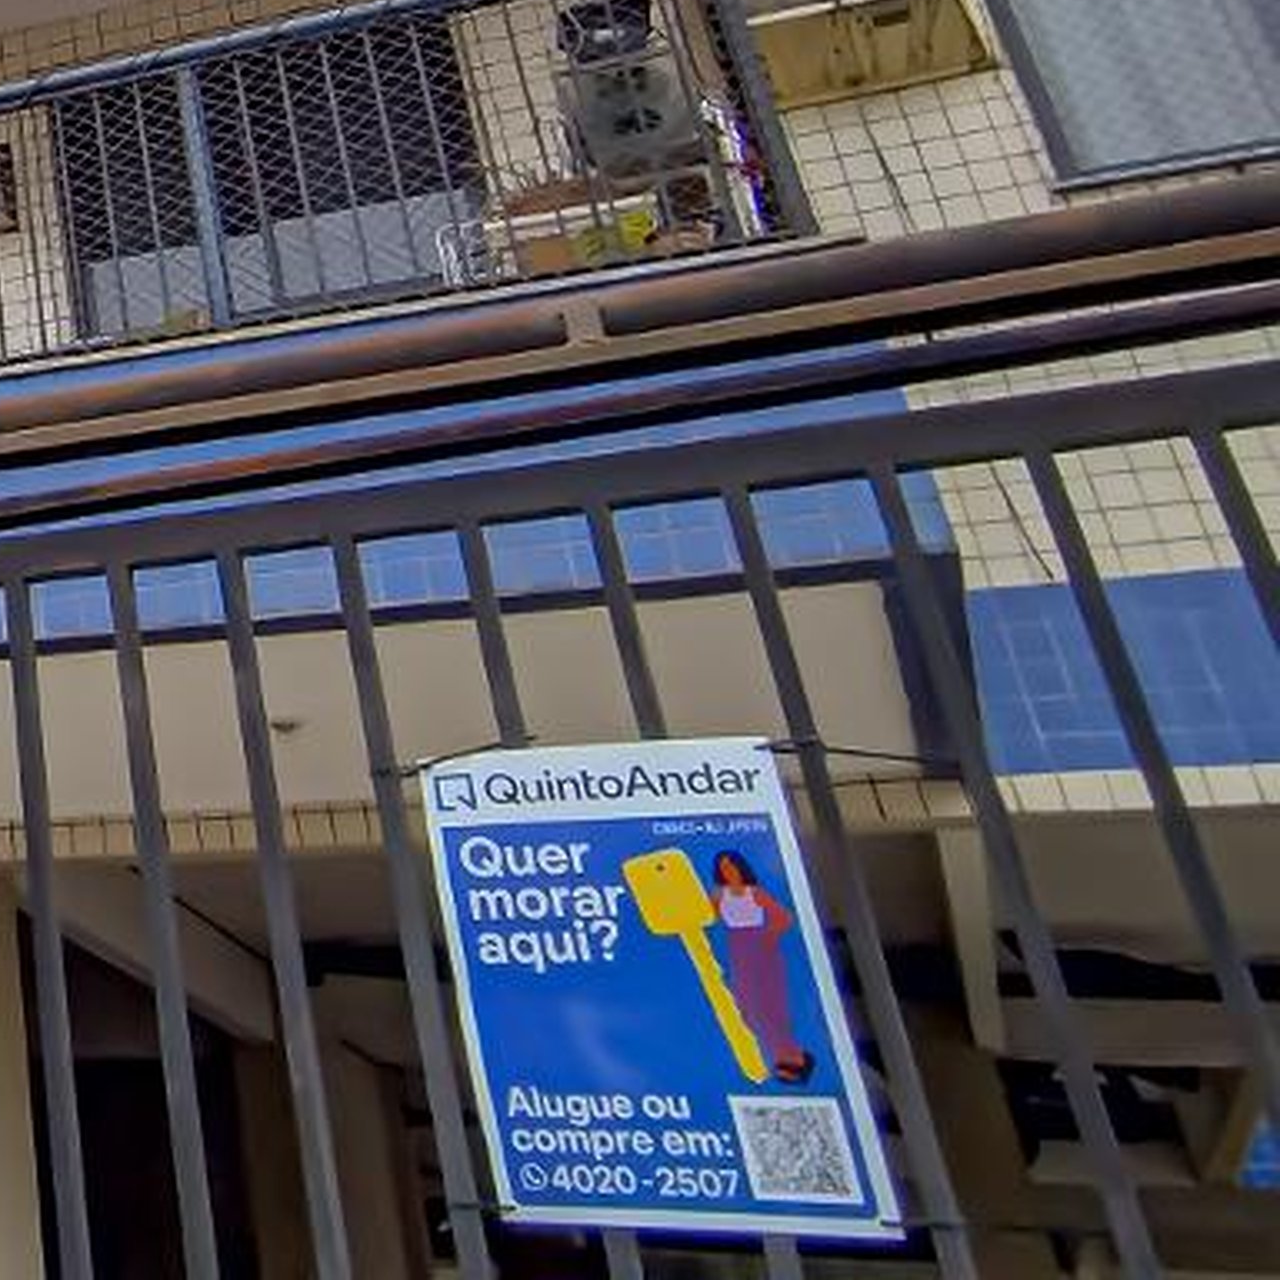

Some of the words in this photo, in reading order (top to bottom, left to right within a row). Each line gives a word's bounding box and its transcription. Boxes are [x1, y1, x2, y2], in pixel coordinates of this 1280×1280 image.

[483, 762, 762, 805] QuintoAndar
[458, 835, 590, 879] Quer
[469, 884, 625, 921] morar
[477, 919, 619, 974] aqui?
[507, 1086, 635, 1127] Alugue
[641, 1094, 690, 1120] ou
[511, 1128, 655, 1161] compre
[662, 1129, 736, 1158] em:
